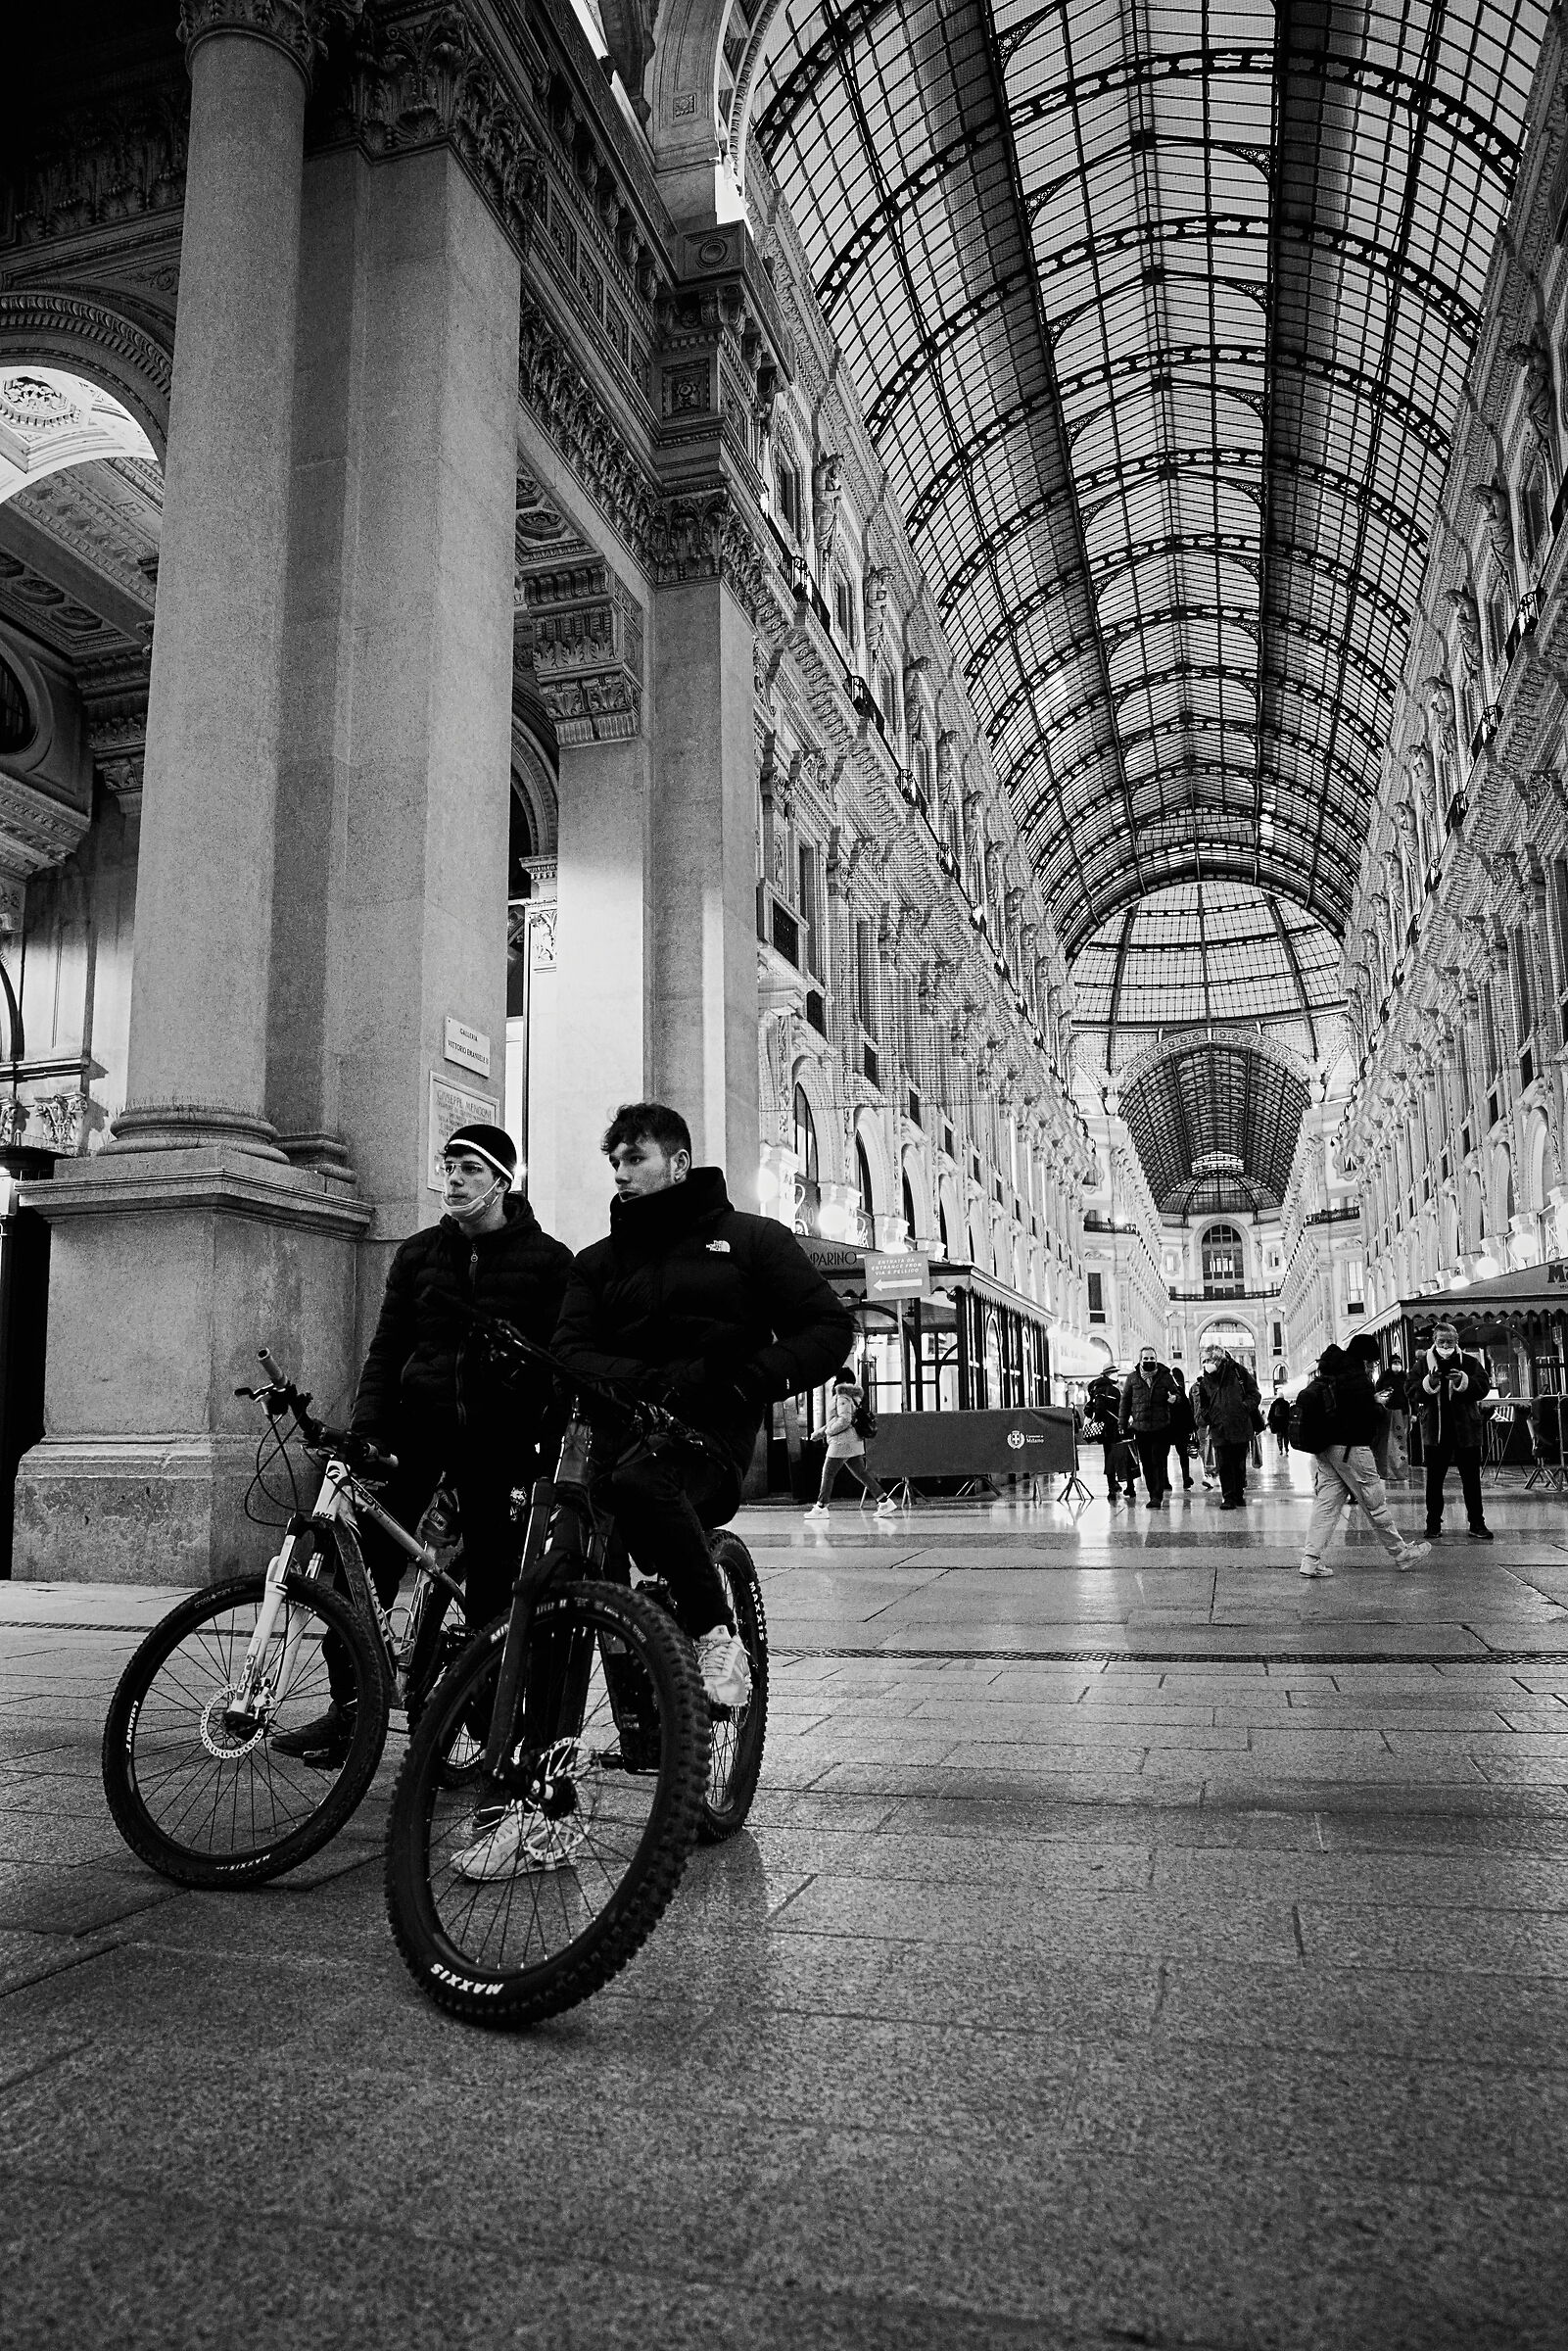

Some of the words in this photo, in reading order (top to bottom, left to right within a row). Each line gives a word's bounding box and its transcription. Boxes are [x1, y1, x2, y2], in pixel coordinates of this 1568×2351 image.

[448, 1039, 467, 1055] VITTORIO
[466, 1048, 486, 1064] EMANUELE
[810, 1251, 857, 1266] PARINO
[748, 1580, 765, 1641] MAXXIS
[125, 1700, 139, 1753] GIANT
[430, 1963, 504, 1994] MAXXIS
